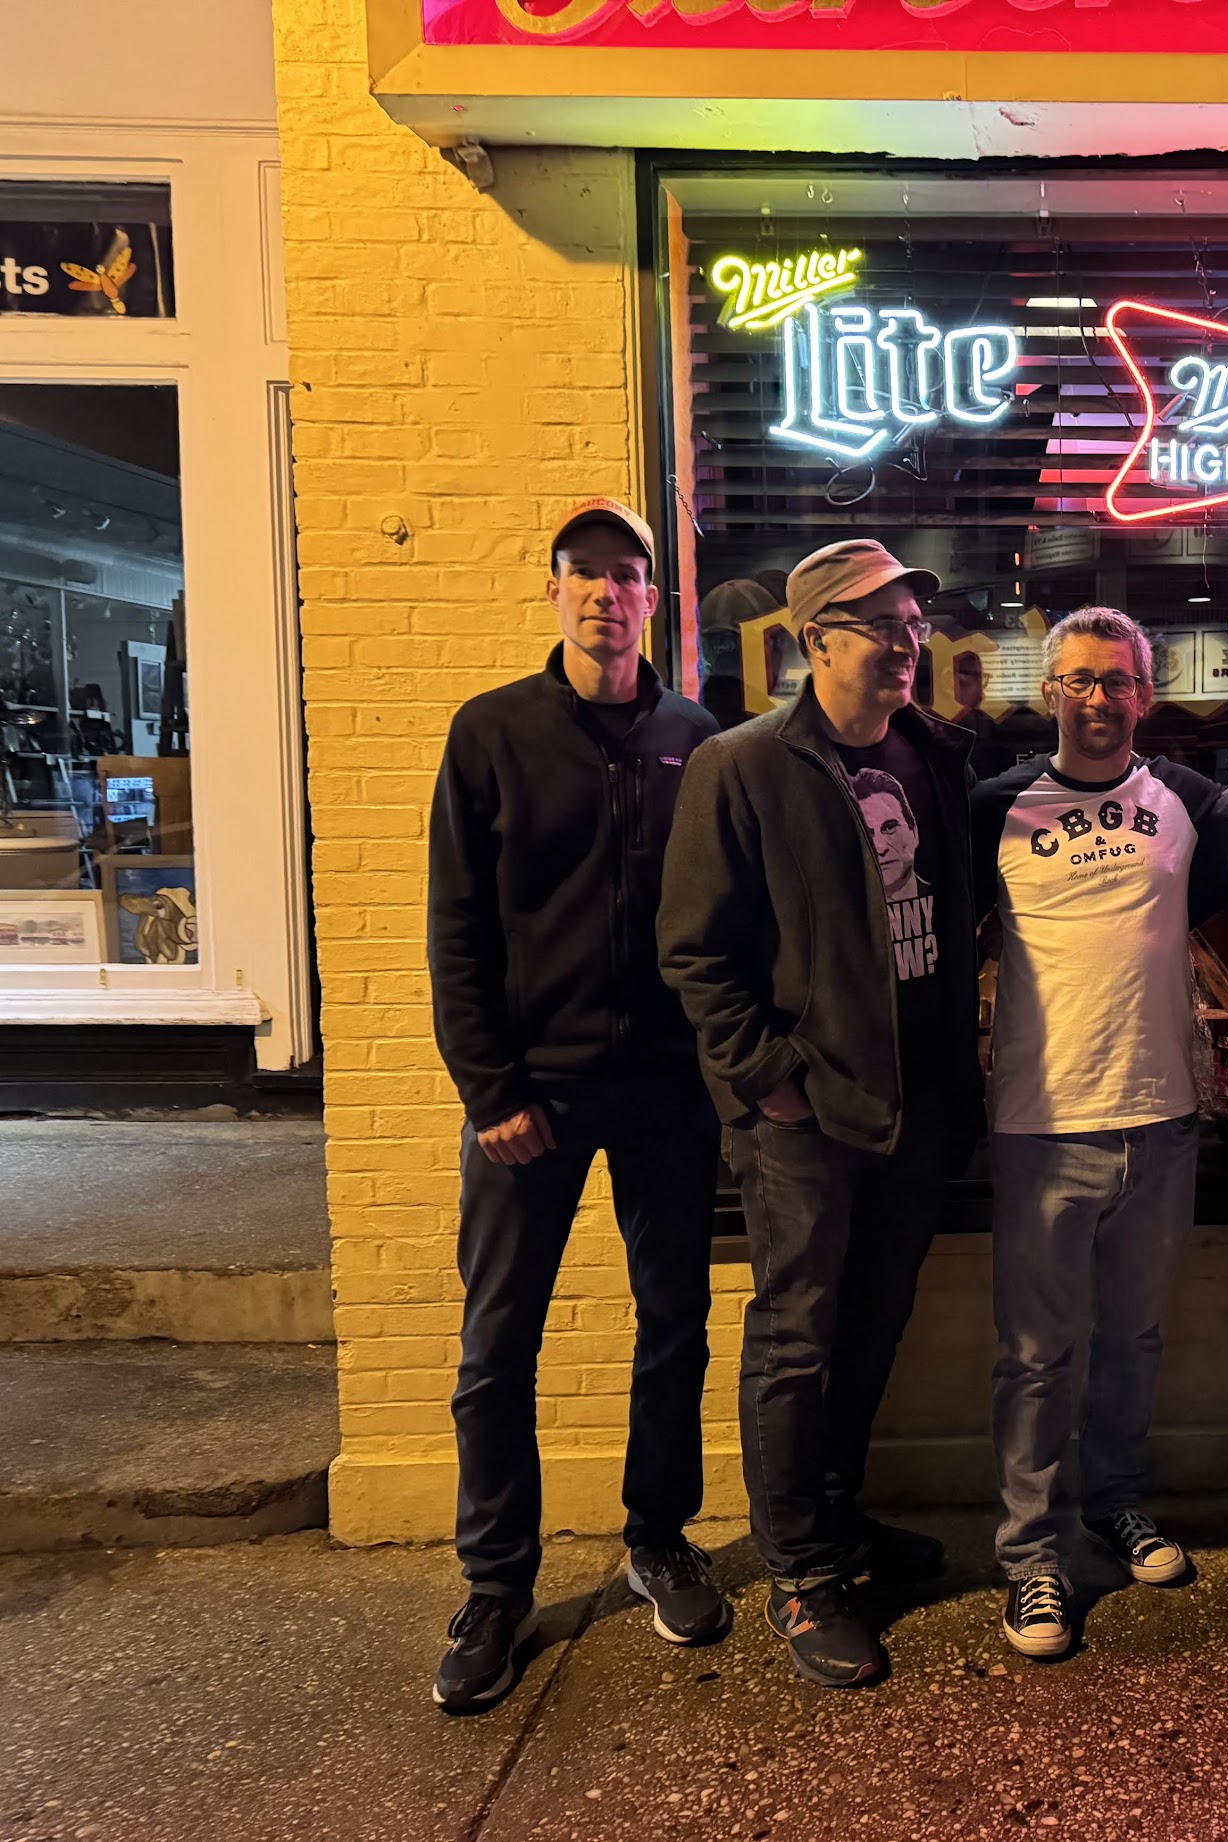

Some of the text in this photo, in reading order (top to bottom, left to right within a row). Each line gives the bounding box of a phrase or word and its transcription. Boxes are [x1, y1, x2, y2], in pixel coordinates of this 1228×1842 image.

[0, 257, 50, 295] ts
[711, 248, 862, 313] Miller
[769, 303, 1017, 457] Lite
[1031, 800, 1160, 857] CBGB
[1095, 835, 1107, 846] &
[1067, 857, 1146, 881] Home of Underground
[1070, 843, 1136, 865] OMFUG
